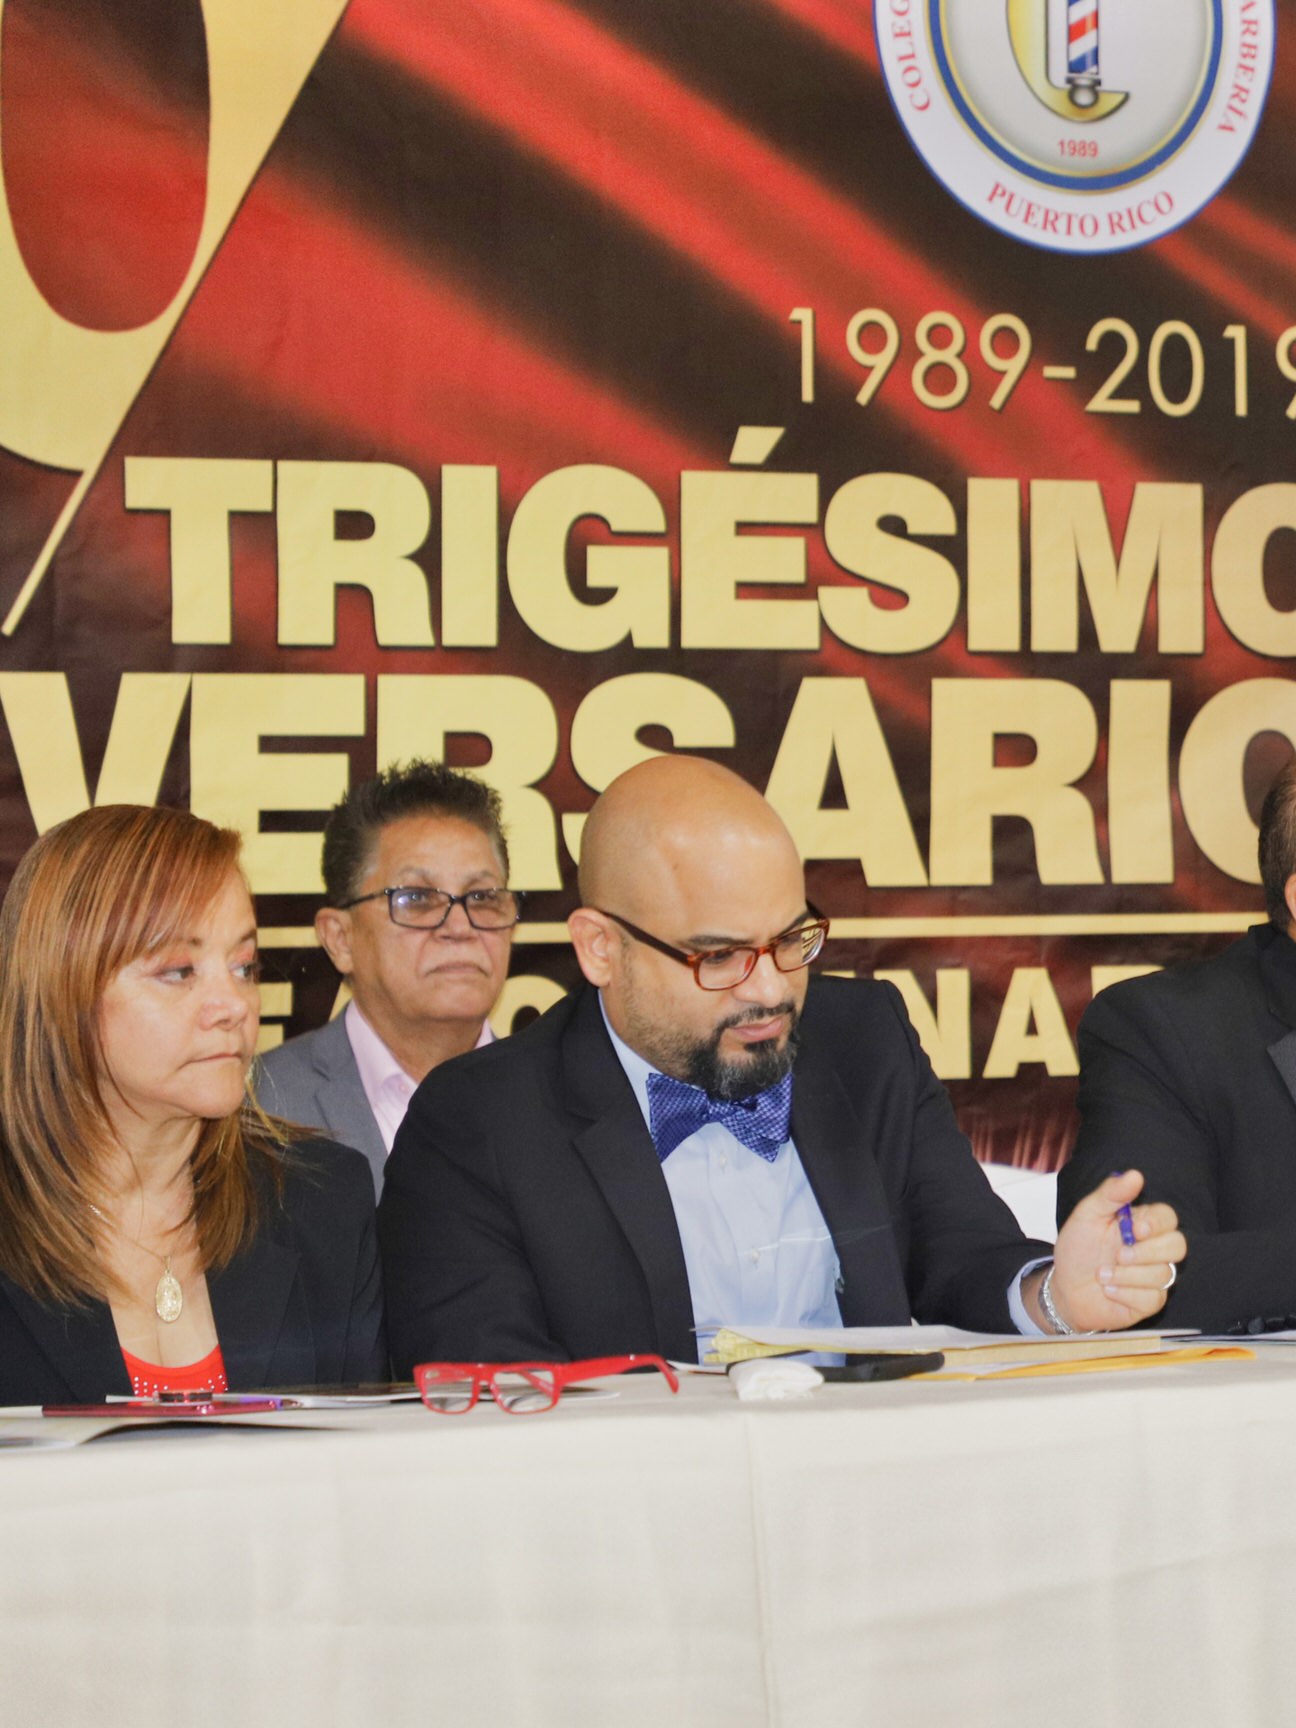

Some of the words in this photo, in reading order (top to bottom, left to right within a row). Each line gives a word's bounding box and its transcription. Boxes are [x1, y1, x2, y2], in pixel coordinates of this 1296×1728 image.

[1058, 139, 1099, 158] 1989
[986, 181, 1099, 238] PUERTO
[1107, 190, 1174, 236] RICO
